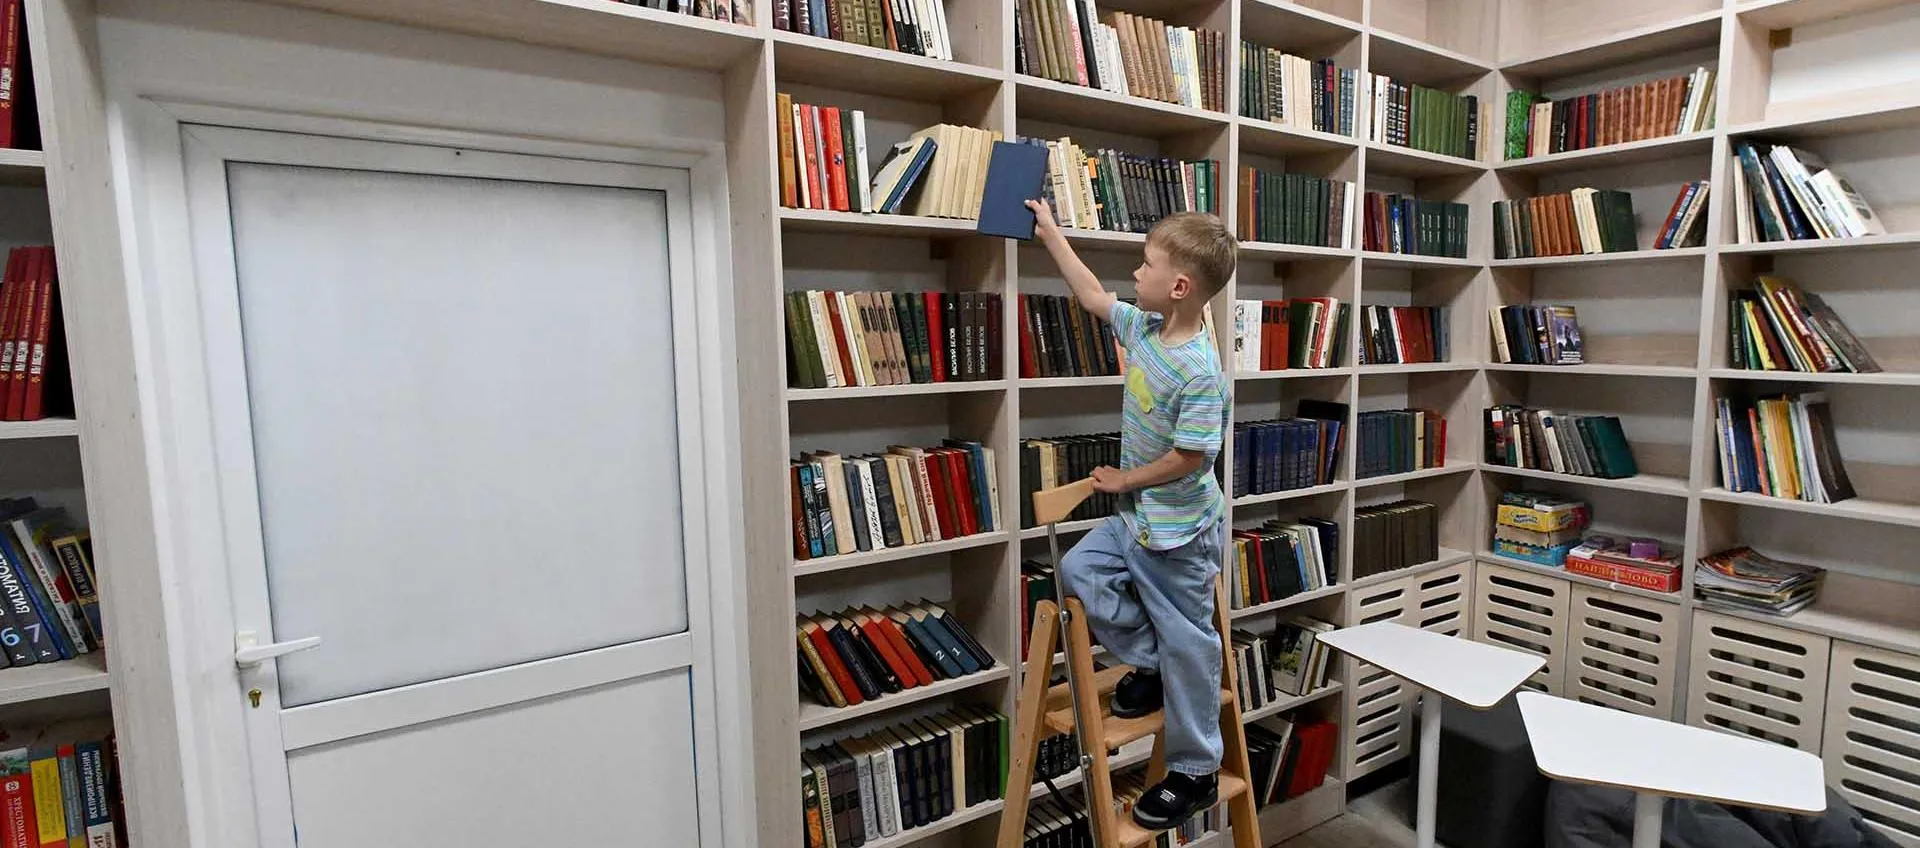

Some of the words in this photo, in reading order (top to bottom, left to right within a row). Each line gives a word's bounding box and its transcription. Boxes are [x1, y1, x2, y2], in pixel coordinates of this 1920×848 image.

[949, 327, 957, 347] БЕЛОВ
[0, 626, 20, 646] 6
[24, 622, 41, 644] 7
[935, 649, 945, 661] 2
[951, 646, 961, 657] 1
